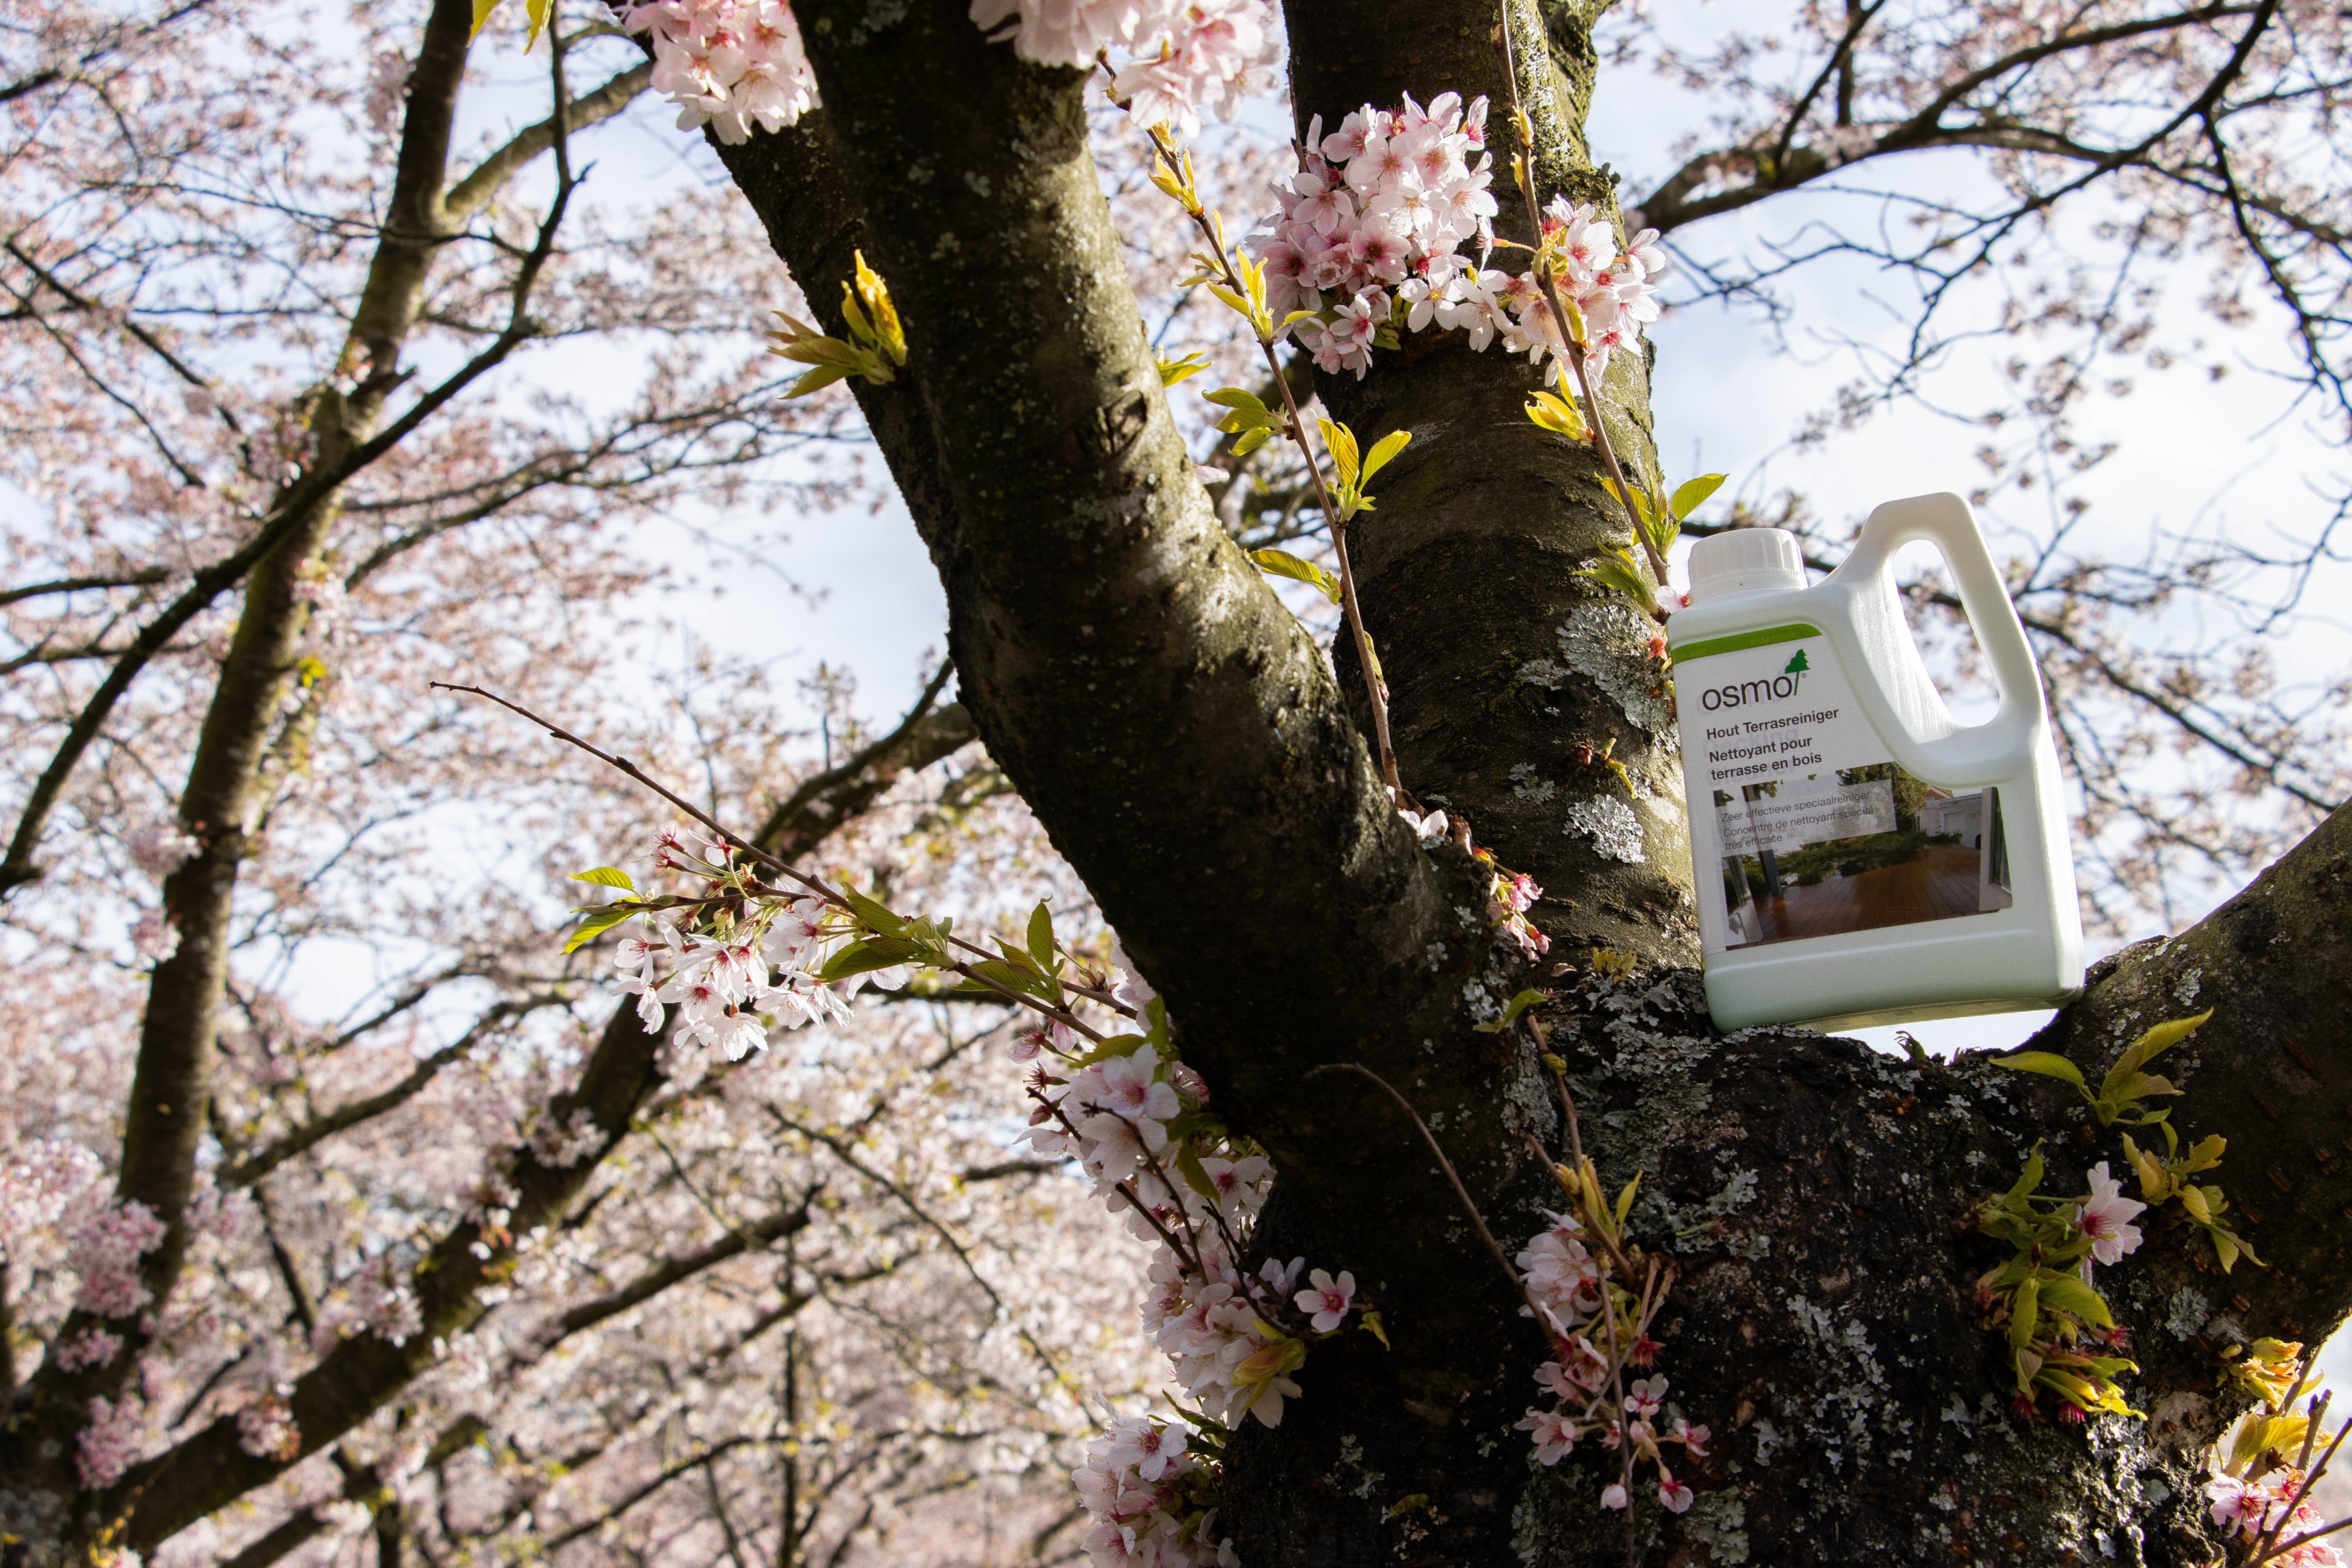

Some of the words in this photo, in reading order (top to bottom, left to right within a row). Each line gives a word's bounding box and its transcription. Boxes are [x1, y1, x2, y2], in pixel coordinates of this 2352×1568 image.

[1702, 675, 1793, 711] osmo
[1706, 724, 1740, 740] Hout
[1743, 709, 1839, 733] Terrasreiniger
[1709, 742, 1776, 763] Nettoyant
[1781, 736, 1812, 753] pour
[1711, 764, 1768, 780] terrasse
[1771, 759, 1789, 769] en
[1792, 752, 1822, 767] bois
[1721, 812, 1743, 822] Zeer
[1746, 803, 1791, 819] effectieve
[1794, 791, 1870, 812] speciaalreiniger
[1723, 822, 1773, 838] Concentré
[1775, 819, 1788, 829] de
[1790, 812, 1835, 827] nettoyant
[1838, 806, 1874, 821] spécial
[1725, 840, 1743, 850] très
[1745, 833, 1782, 848] efficace
